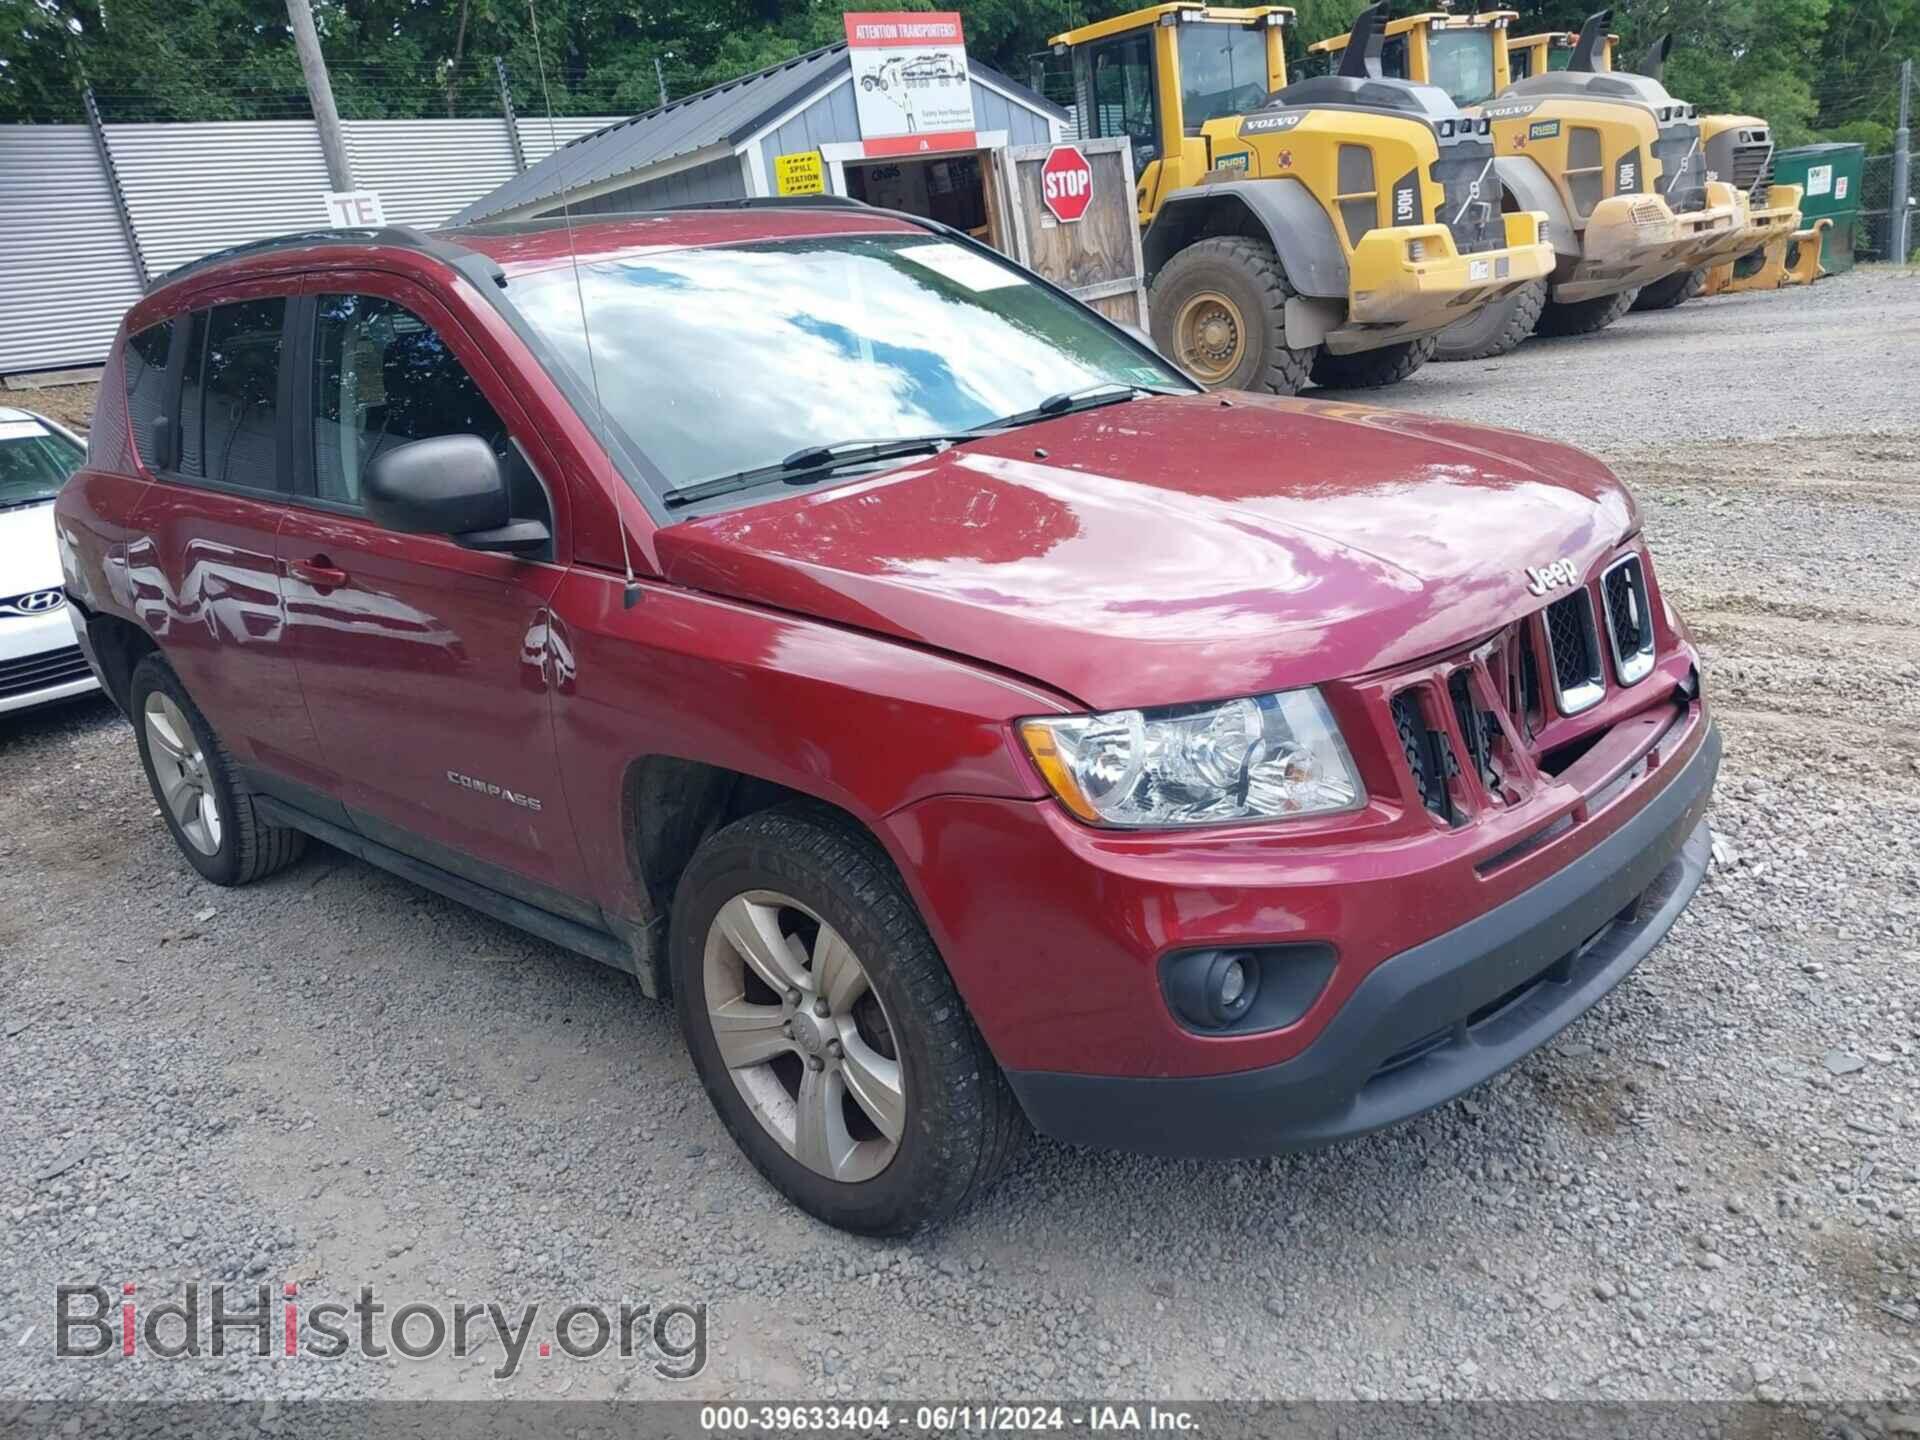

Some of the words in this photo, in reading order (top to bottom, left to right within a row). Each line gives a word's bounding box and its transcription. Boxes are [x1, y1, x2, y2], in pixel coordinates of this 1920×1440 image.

[857, 25, 897, 39] ATTENTION
[1247, 116, 1298, 130] VOLVO
[1486, 105, 1533, 117] VOLVO
[785, 174, 818, 184] STATION
[790, 164, 812, 173] SPILL
[1620, 163, 1634, 190] L90H
[1046, 169, 1089, 198] STOP
[333, 198, 377, 225] TE
[1397, 188, 1413, 220] L90H
[1525, 558, 1577, 595] Jeep
[447, 770, 542, 811] COMPASS
